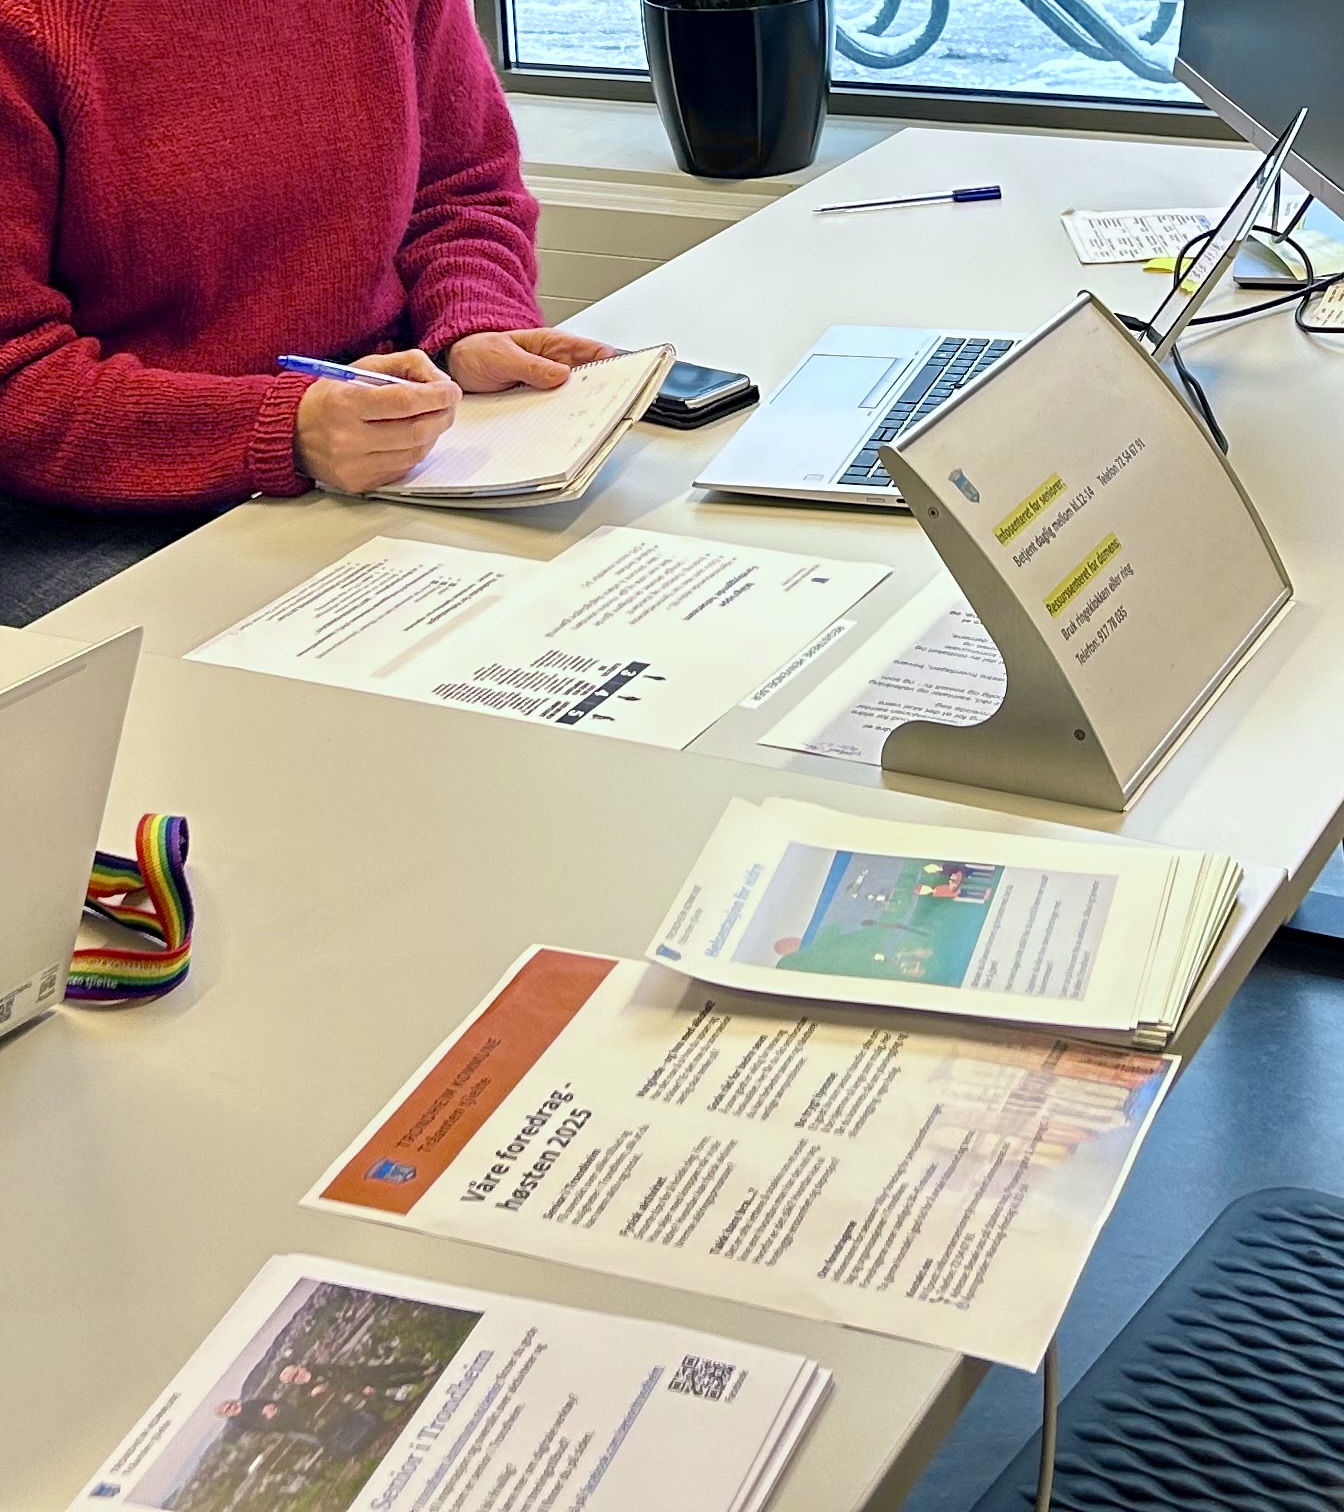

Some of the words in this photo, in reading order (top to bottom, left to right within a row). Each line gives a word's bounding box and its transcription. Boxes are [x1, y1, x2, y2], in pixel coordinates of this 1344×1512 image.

[1097, 467, 1120, 486] Telefon
[1114, 456, 1126, 469] 72
[1122, 450, 1132, 463] 54
[1135, 438, 1146, 450] 91
[1029, 500, 1041, 513] for
[1013, 542, 1038, 567] Betjent
[1087, 559, 1098, 572] for
[1061, 619, 1077, 641] Bruk
[1120, 563, 1134, 580] ring
[1075, 638, 1100, 666] Telefon:
[1097, 623, 1109, 643] 917
[1107, 616, 1118, 632] 78
[1115, 605, 1128, 623] 035
[460, 1162, 509, 1203] Våre
[496, 1089, 574, 1160] foredrag
[495, 1149, 561, 1211] høsten
[548, 1108, 592, 1148] 2025
